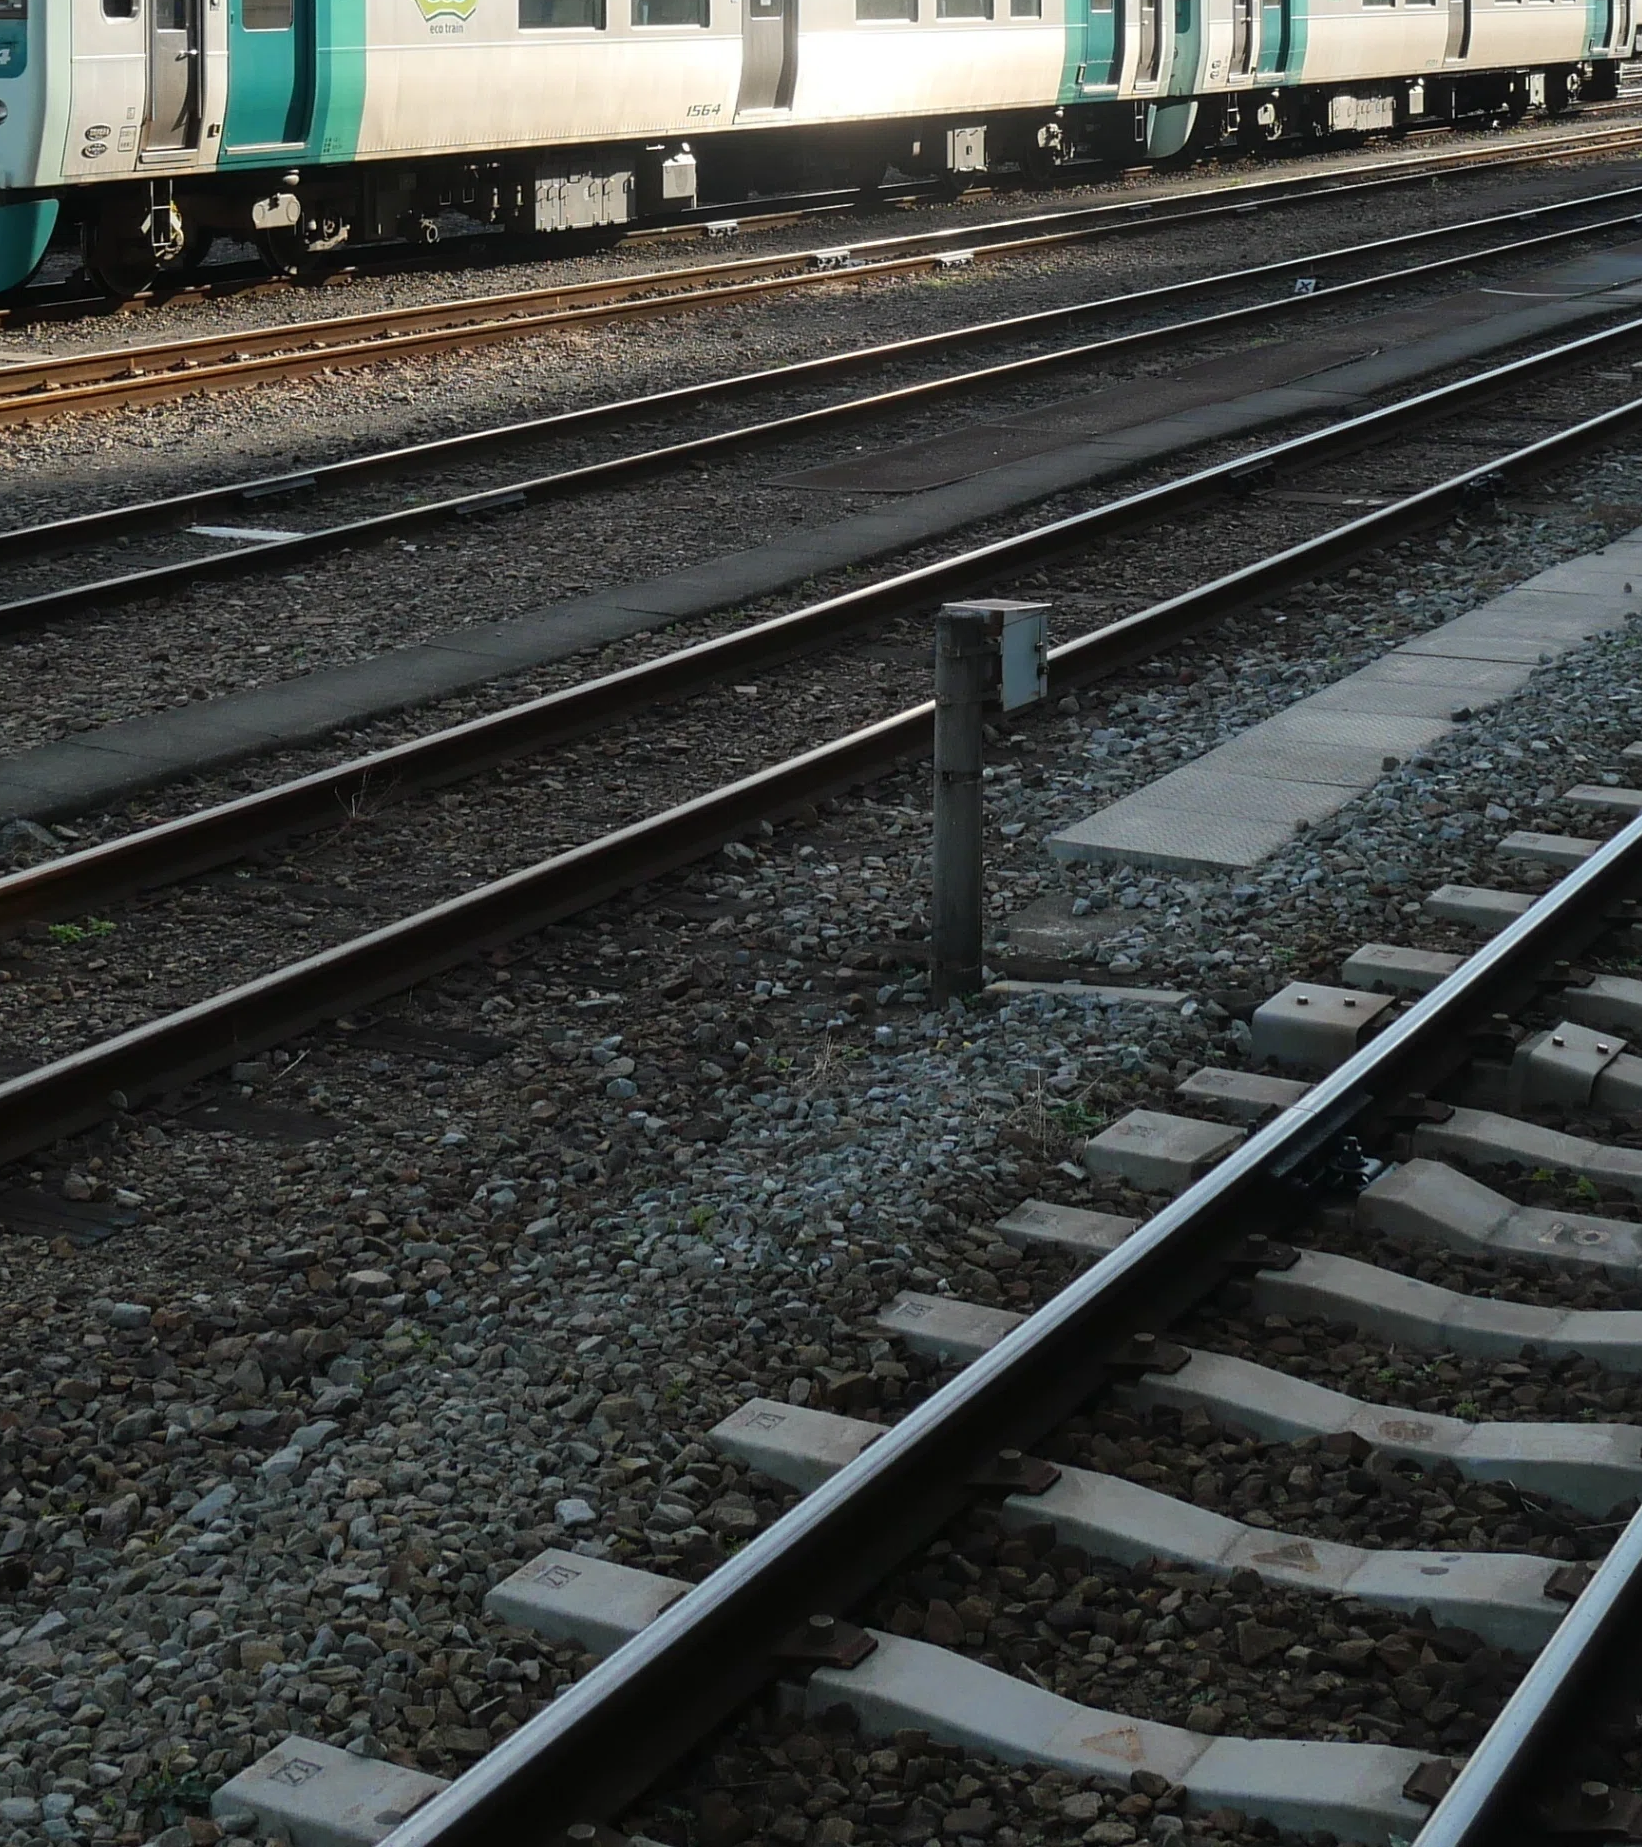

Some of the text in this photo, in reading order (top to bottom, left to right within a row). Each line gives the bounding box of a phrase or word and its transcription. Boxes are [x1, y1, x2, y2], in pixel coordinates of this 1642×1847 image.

[429, 23, 464, 34] eco train
[686, 104, 721, 117] 1564
